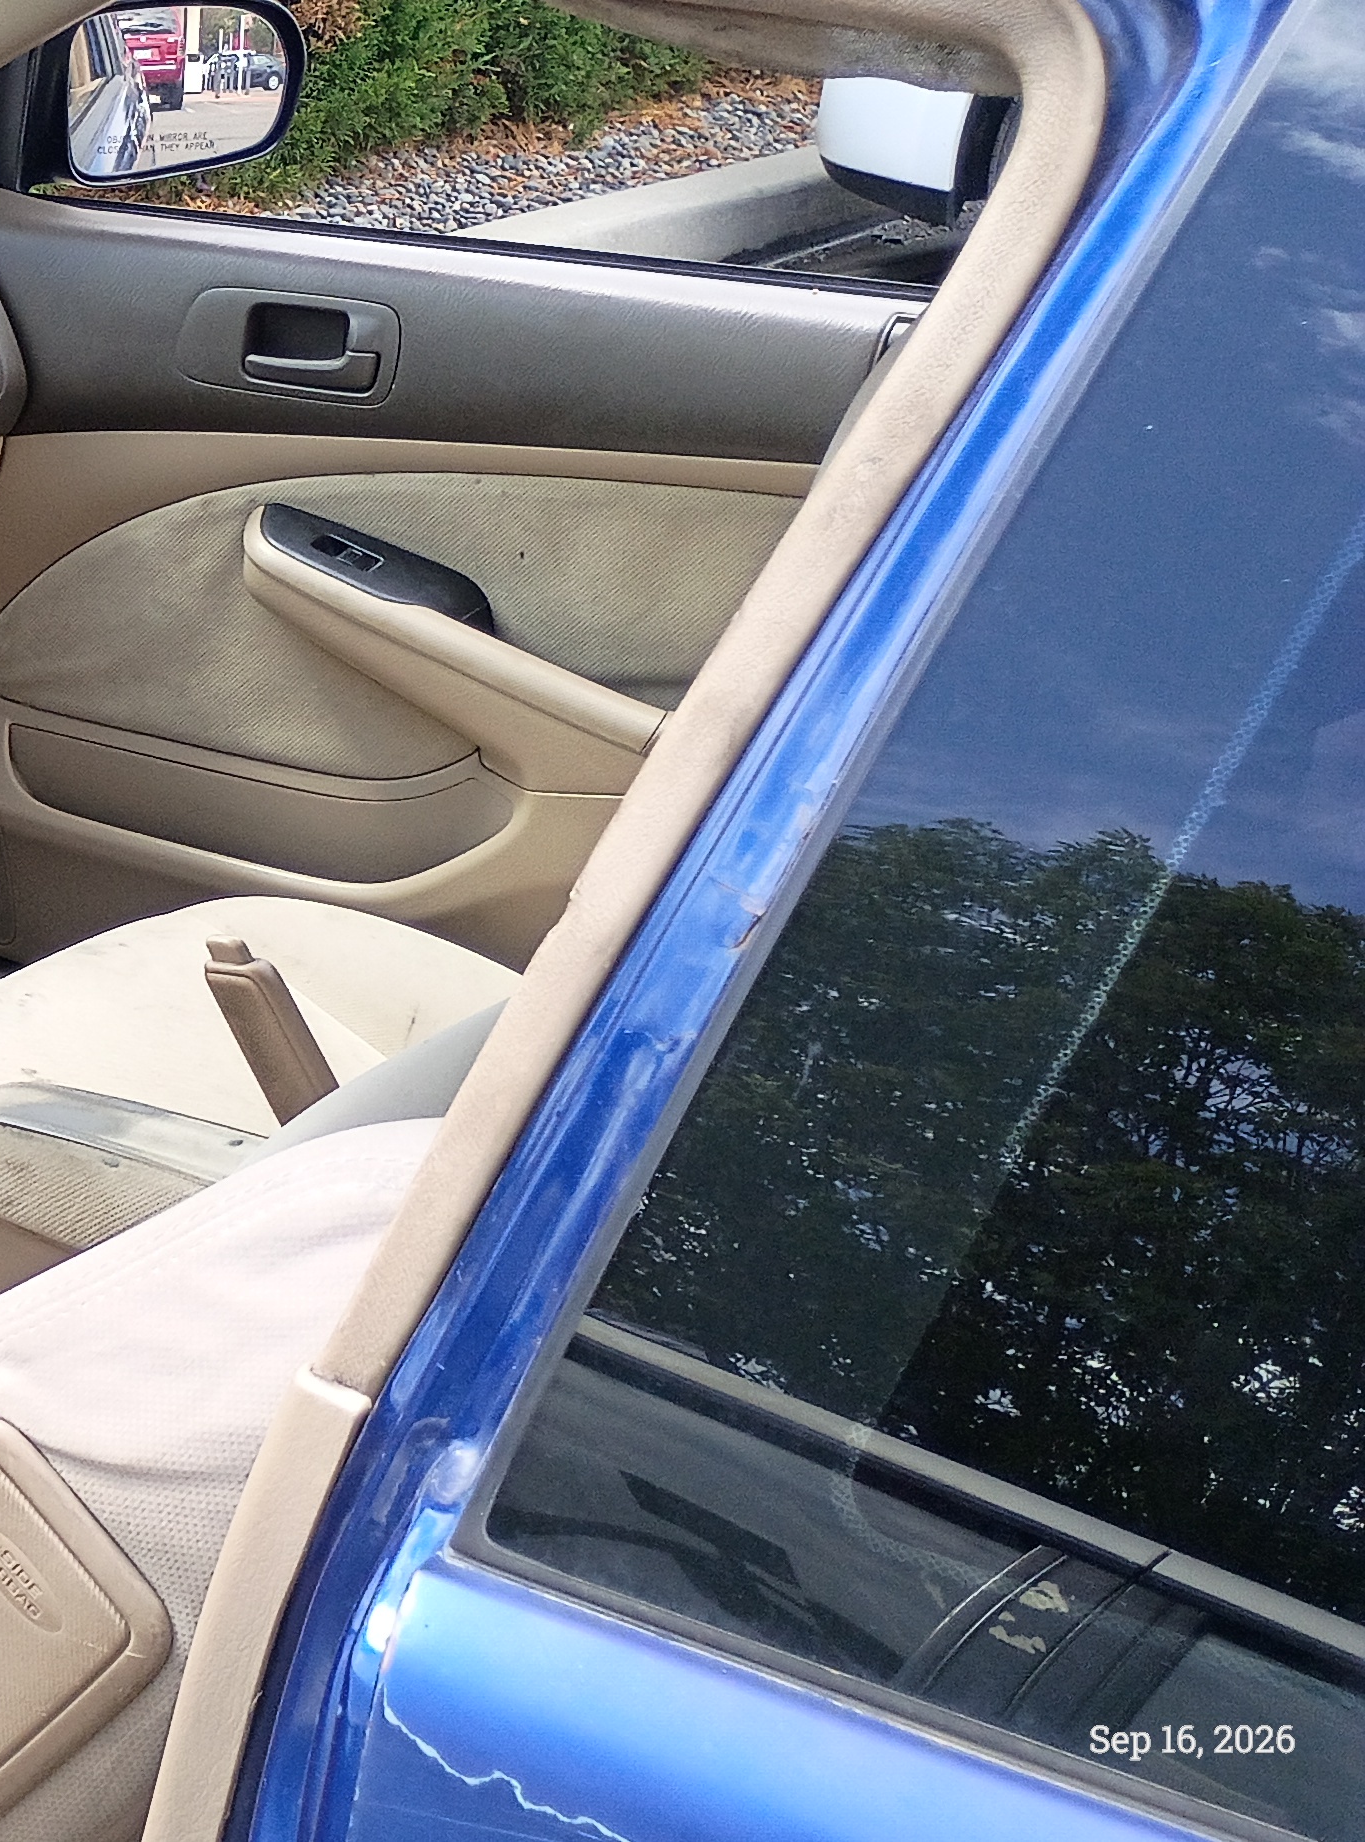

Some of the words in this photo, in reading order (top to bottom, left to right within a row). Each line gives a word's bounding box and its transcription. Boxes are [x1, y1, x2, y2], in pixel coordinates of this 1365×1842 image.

[193, 131, 208, 141] ARE
[160, 142, 180, 152] THEY
[0, 1549, 44, 1600] SIDE
